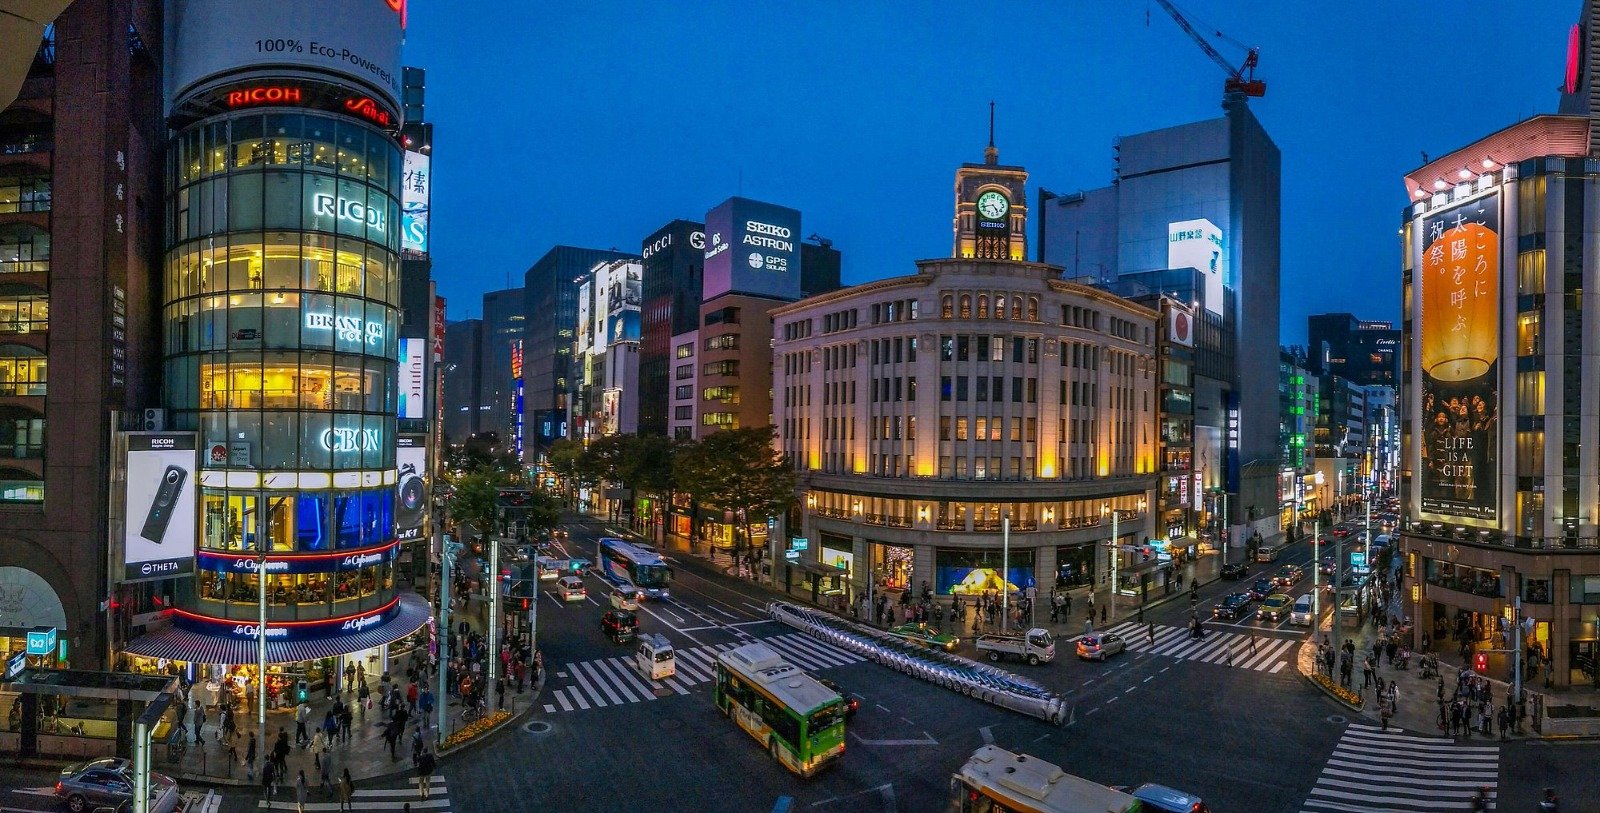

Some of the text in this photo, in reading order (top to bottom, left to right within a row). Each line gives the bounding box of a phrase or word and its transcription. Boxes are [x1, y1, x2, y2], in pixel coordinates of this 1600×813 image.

[255, 39, 303, 54] 100%
[310, 42, 392, 86] Eco-Powered
[228, 88, 300, 107] RICOH
[746, 220, 791, 239] SEIKO
[980, 221, 1005, 229] SEIKO
[642, 233, 672, 259] GUCCI
[743, 234, 793, 252] ASTRON
[765, 255, 787, 266] GPS
[765, 264, 787, 272] SOLAR
[409, 355, 422, 400] FUJITEC
[1444, 437, 1474, 450] LIFE
[1448, 452, 1470, 462] IS A
[1442, 465, 1474, 478] GIFT
[152, 561, 179, 572] THETA
